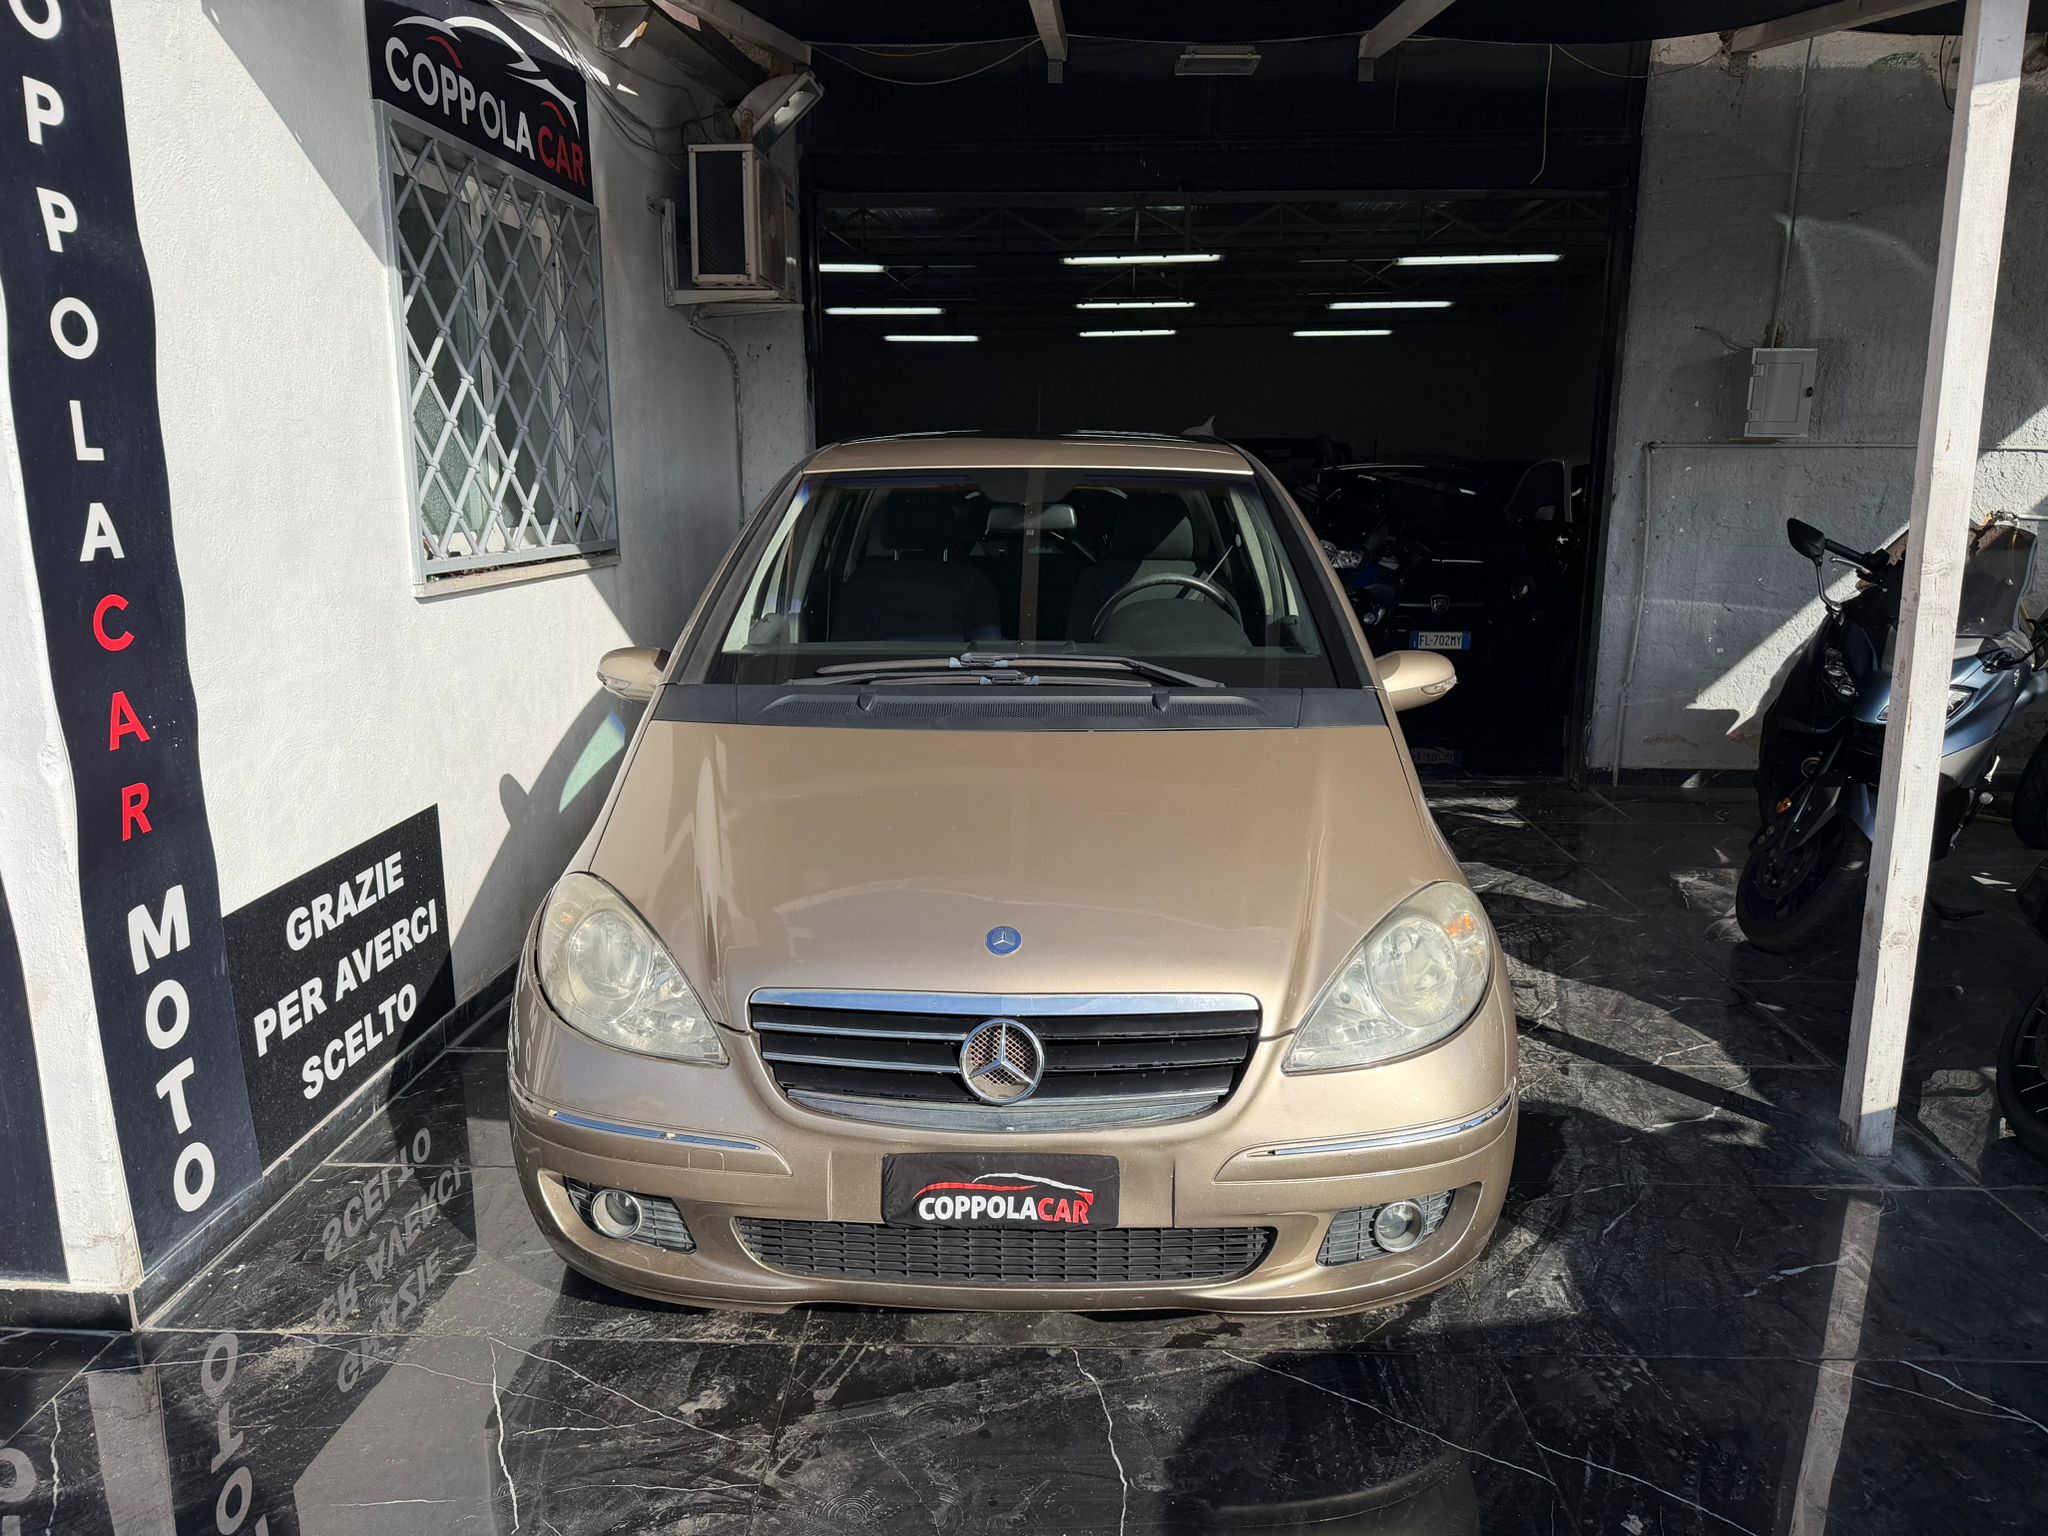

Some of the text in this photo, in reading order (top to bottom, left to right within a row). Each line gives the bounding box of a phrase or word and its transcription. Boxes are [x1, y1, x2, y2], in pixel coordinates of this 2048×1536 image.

[92, 594, 154, 844] CAR
[127, 884, 216, 1213] MOTO
[286, 850, 405, 951] GRAZIE
[253, 898, 438, 1058] PER AVERCI
[301, 983, 417, 1100] SCELTO
